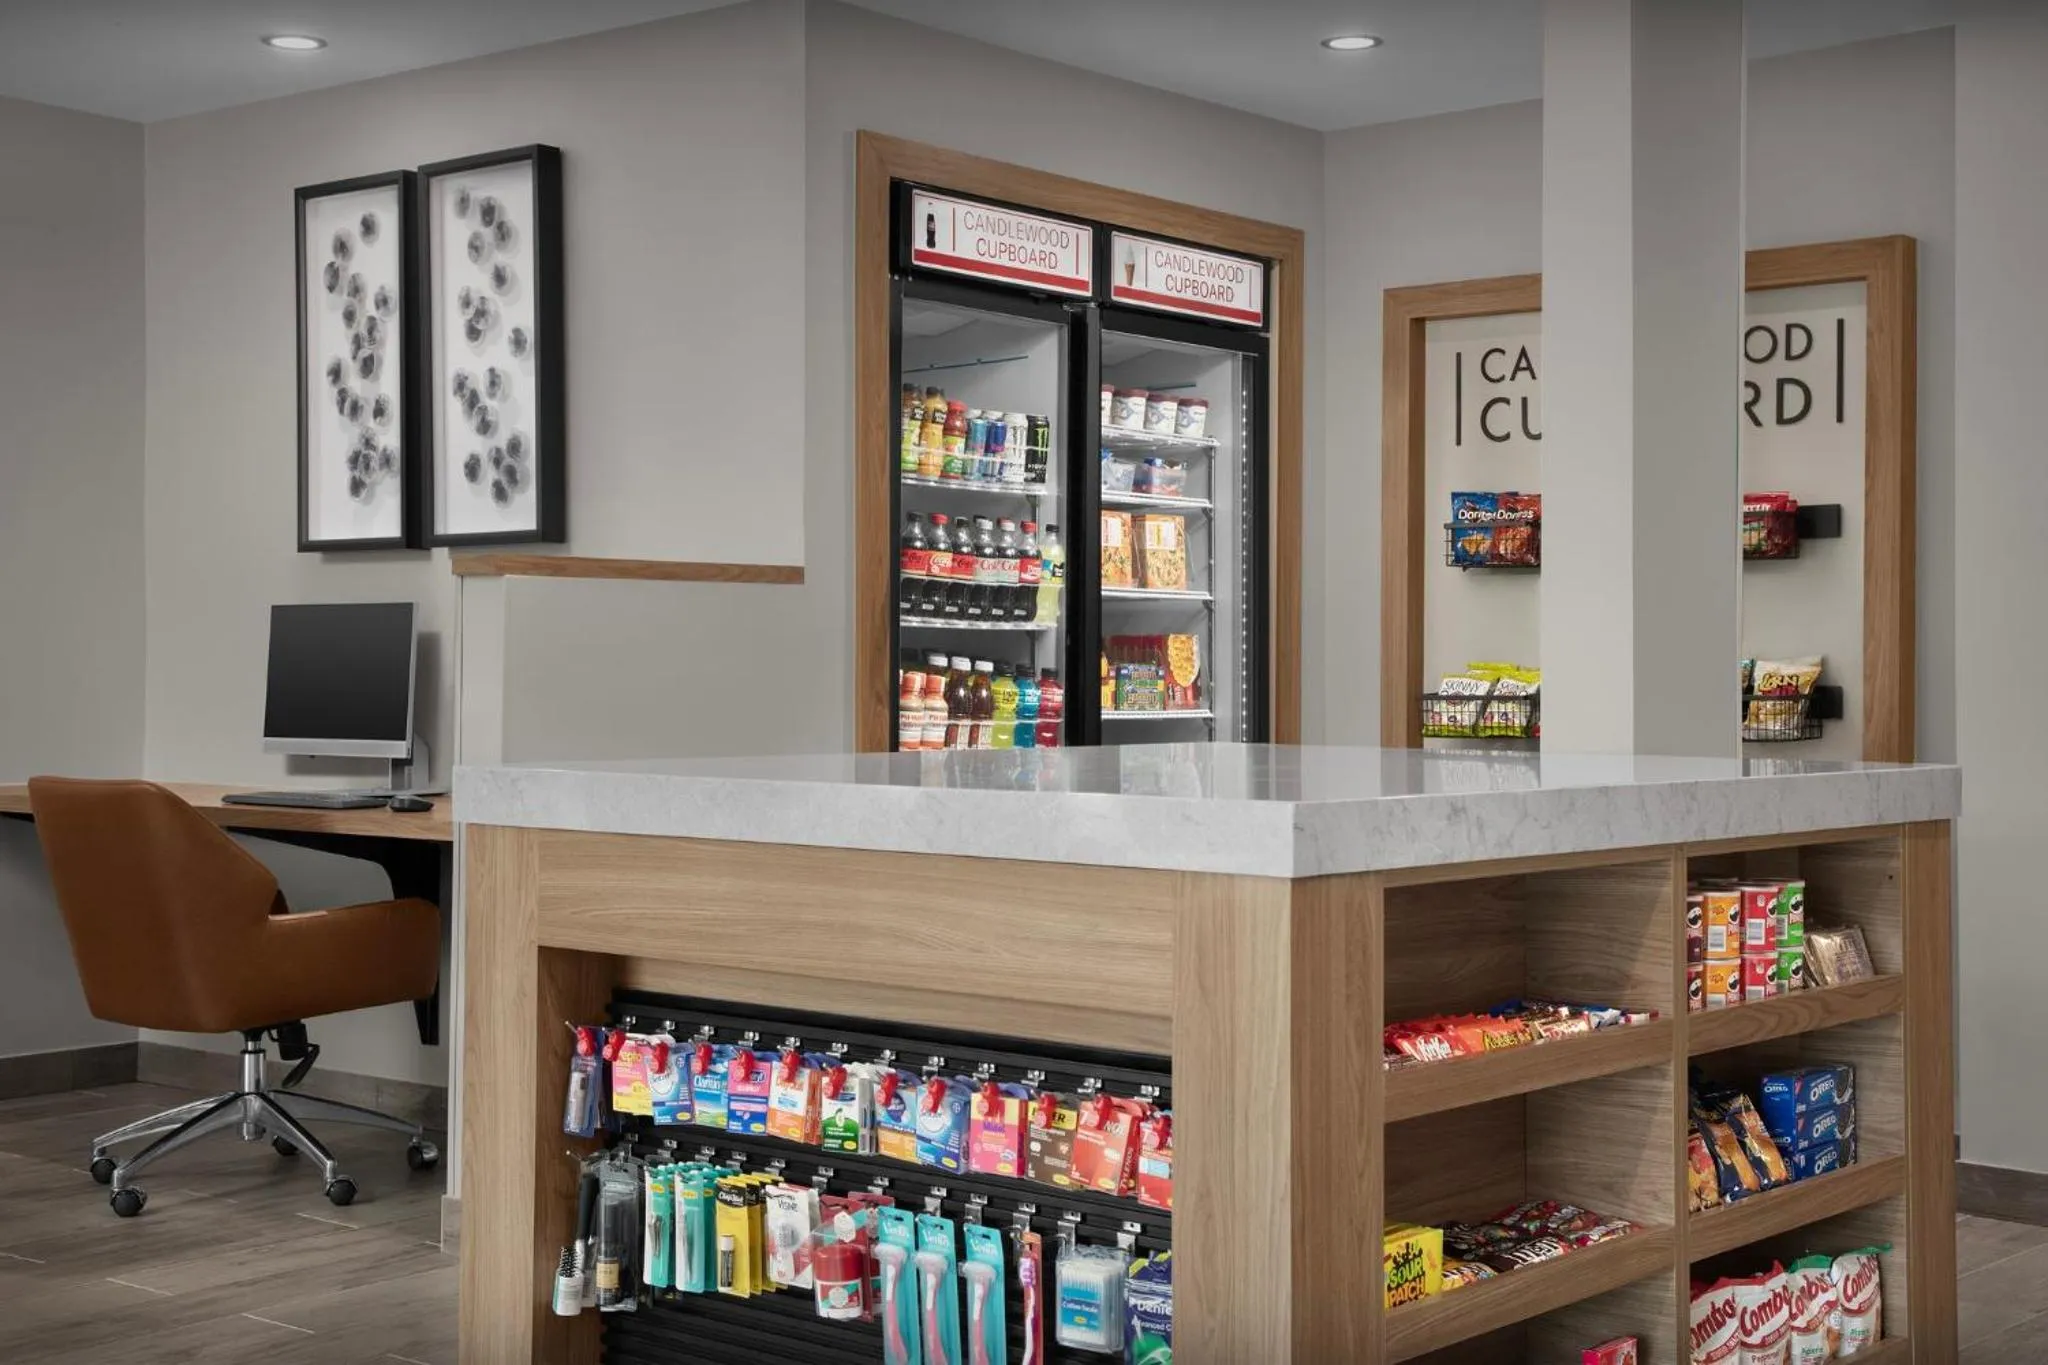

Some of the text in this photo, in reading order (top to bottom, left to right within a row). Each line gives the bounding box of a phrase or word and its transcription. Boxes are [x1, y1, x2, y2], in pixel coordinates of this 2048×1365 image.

[963, 210, 1071, 250] CANDLEWOOD
[975, 237, 1059, 270] CUPBOARD
[1154, 250, 1245, 284] CANDLEWOOD
[1164, 274, 1235, 303] CUPBOARD
[1810, 1079, 1835, 1101] OREO
[1812, 1114, 1837, 1138] OREO
[1389, 1256, 1424, 1288] SOUR
[1389, 1275, 1426, 1304] PATCH
[1740, 1284, 1791, 1337] Combo
